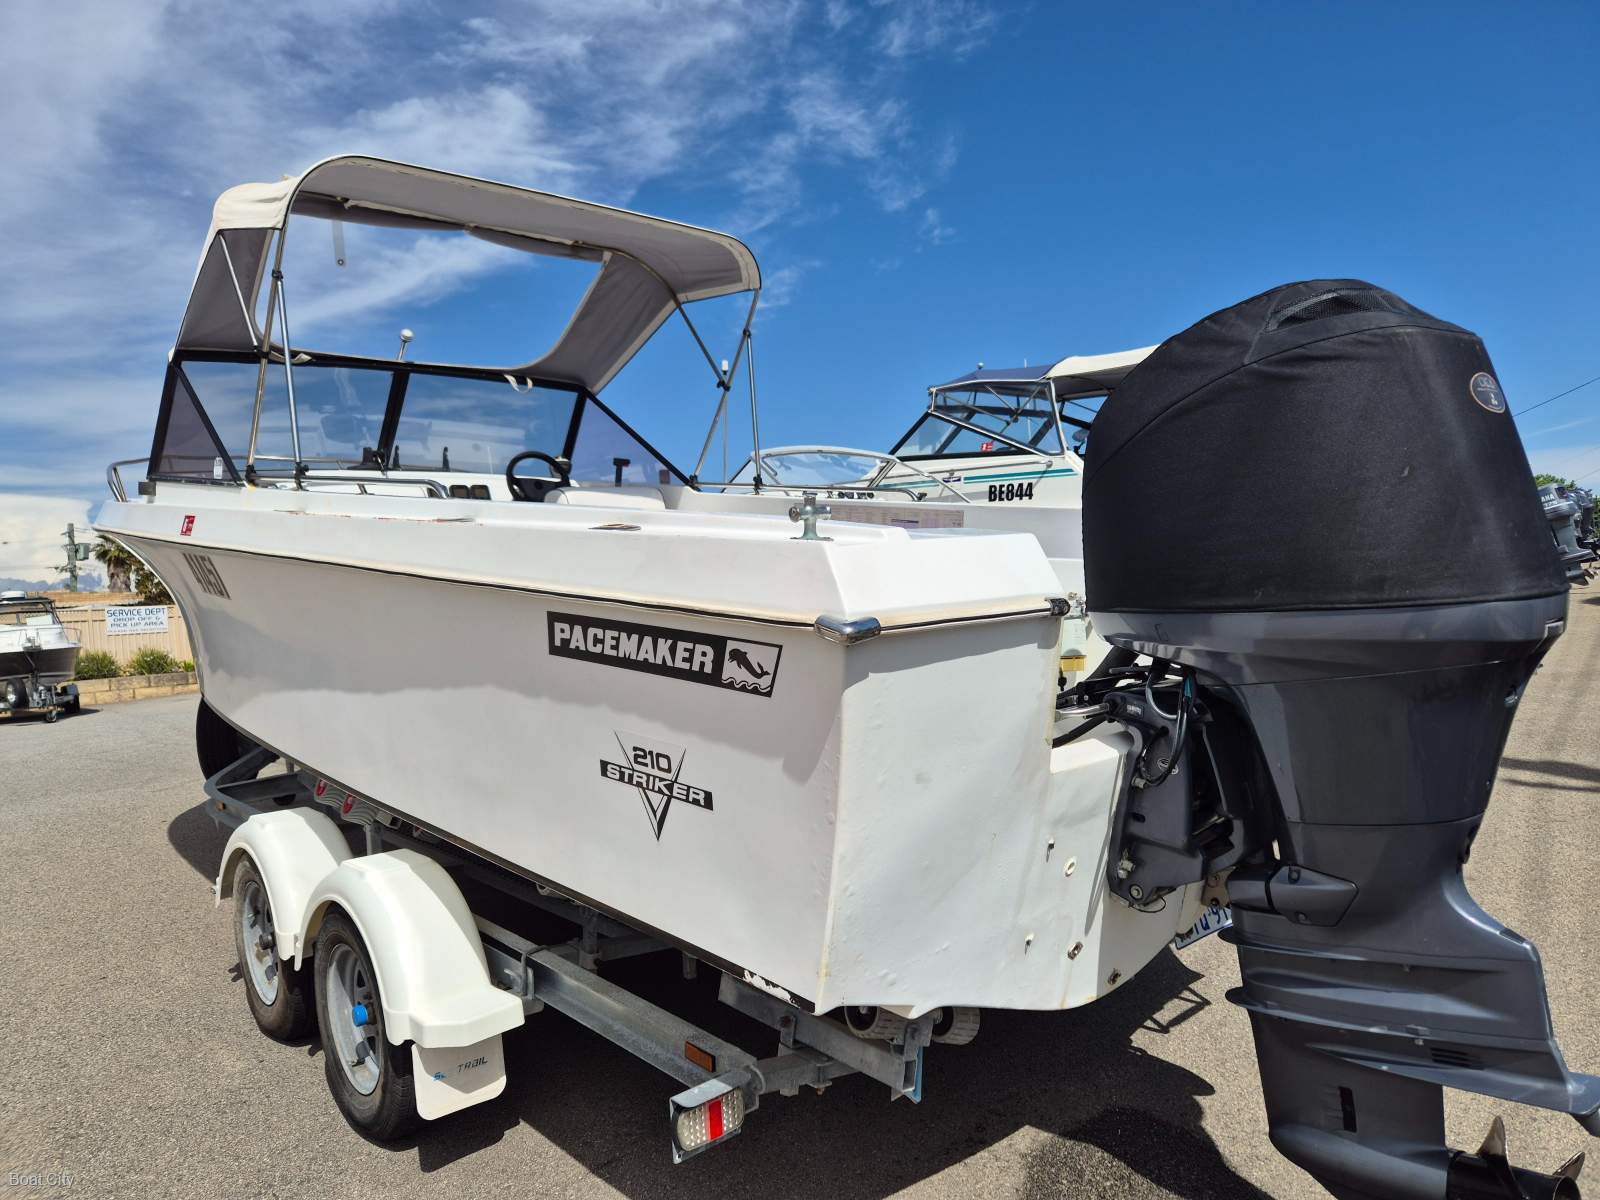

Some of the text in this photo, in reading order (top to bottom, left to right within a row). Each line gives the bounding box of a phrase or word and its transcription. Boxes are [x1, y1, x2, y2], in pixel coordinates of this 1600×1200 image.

[988, 482, 1034, 502] BE844
[106, 607, 166, 618] SERVICE DEPT
[553, 621, 716, 674] PACEMAKER
[632, 746, 672, 774] 210
[606, 763, 706, 806] STRIKER
